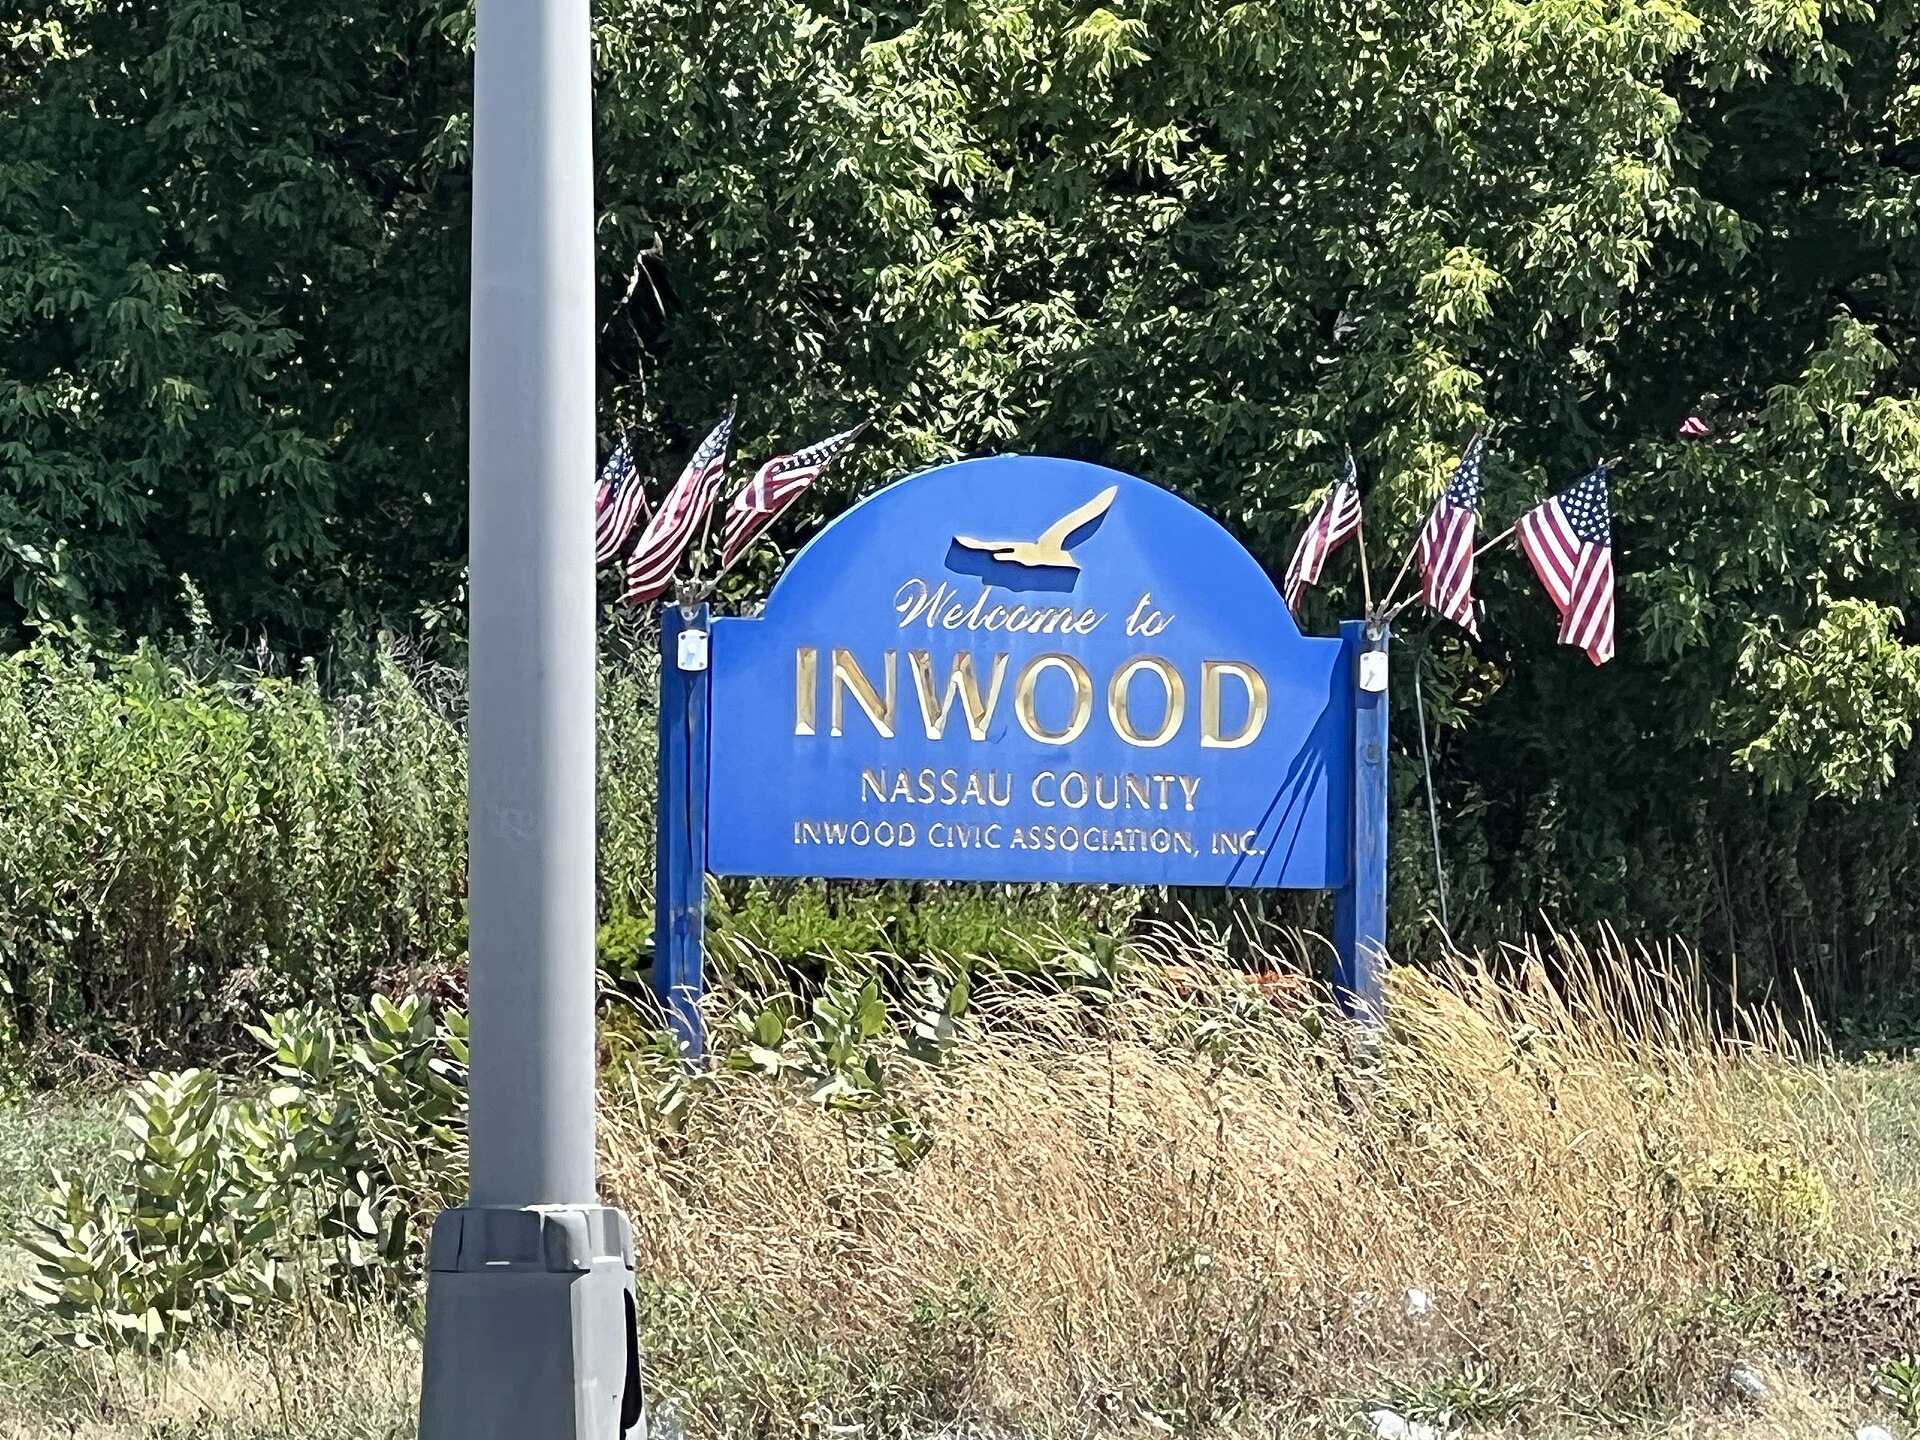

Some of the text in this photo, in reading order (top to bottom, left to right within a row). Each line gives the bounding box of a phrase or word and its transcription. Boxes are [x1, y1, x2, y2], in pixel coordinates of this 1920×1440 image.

[895, 578, 1175, 637] Welcome to
[794, 646, 1269, 749] INWOOD
[860, 768, 1201, 812] NASSAU COUNTY
[793, 821, 1266, 858] INWOOD CIVIC ASSOCIATION, INC.
